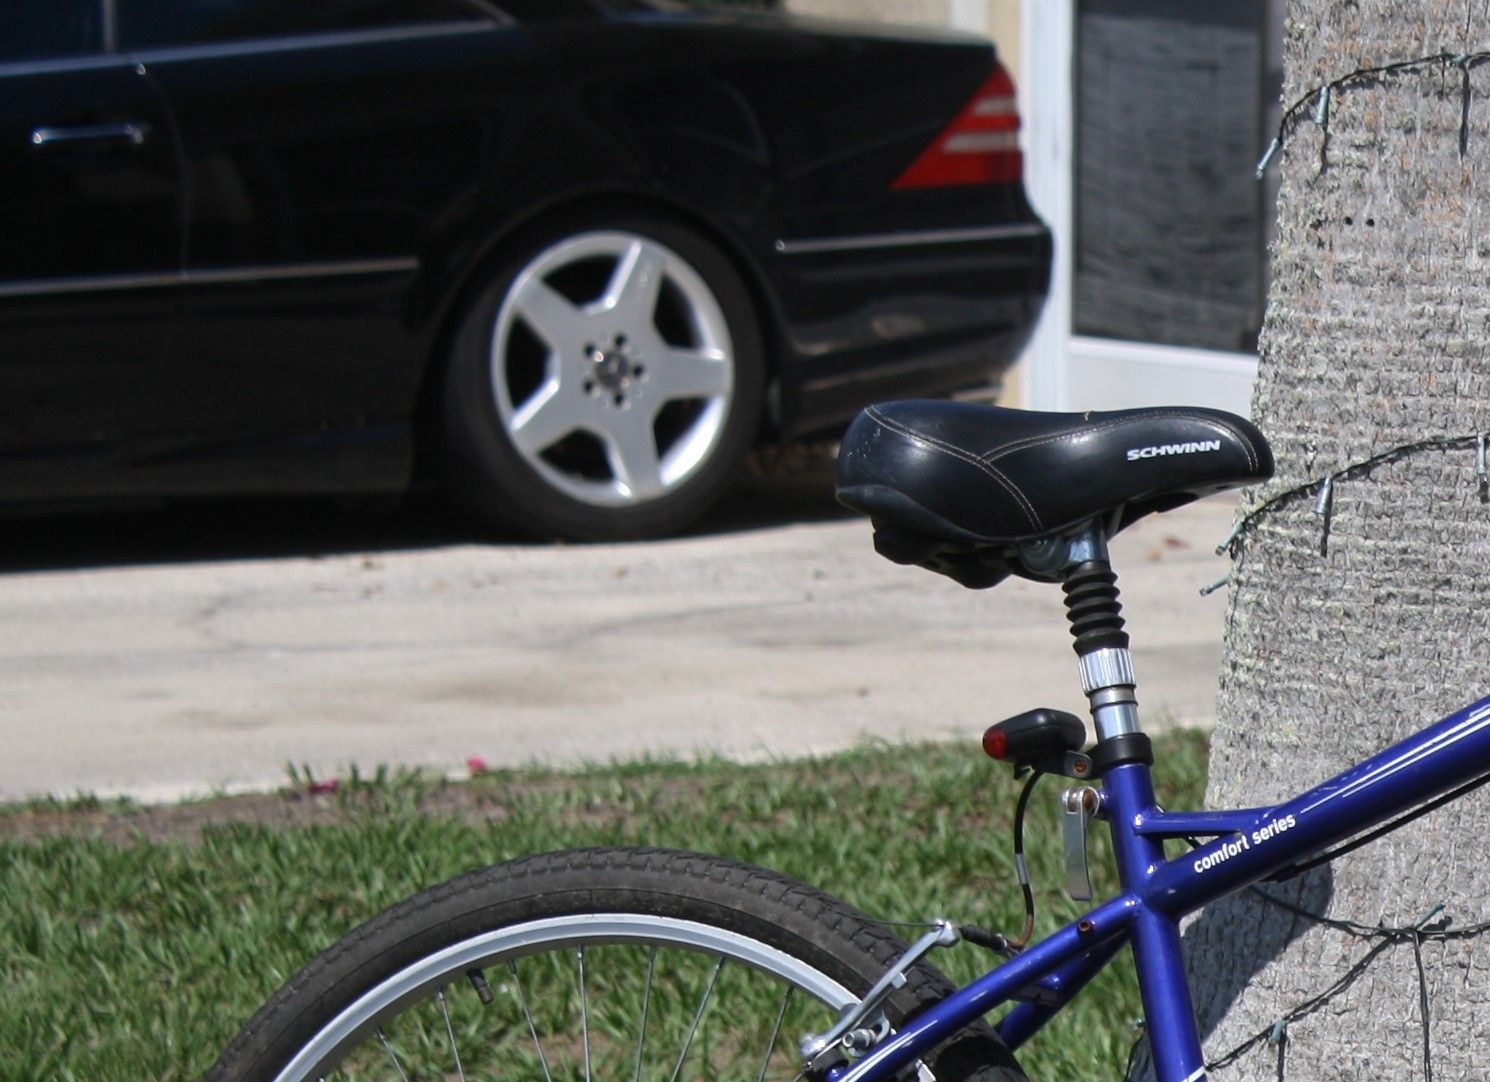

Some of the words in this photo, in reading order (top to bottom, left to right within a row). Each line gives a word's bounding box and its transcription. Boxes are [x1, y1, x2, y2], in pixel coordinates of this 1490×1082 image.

[1126, 439, 1221, 461] SCHWINN
[1193, 834, 1250, 873] comfort
[1251, 814, 1296, 845] series
